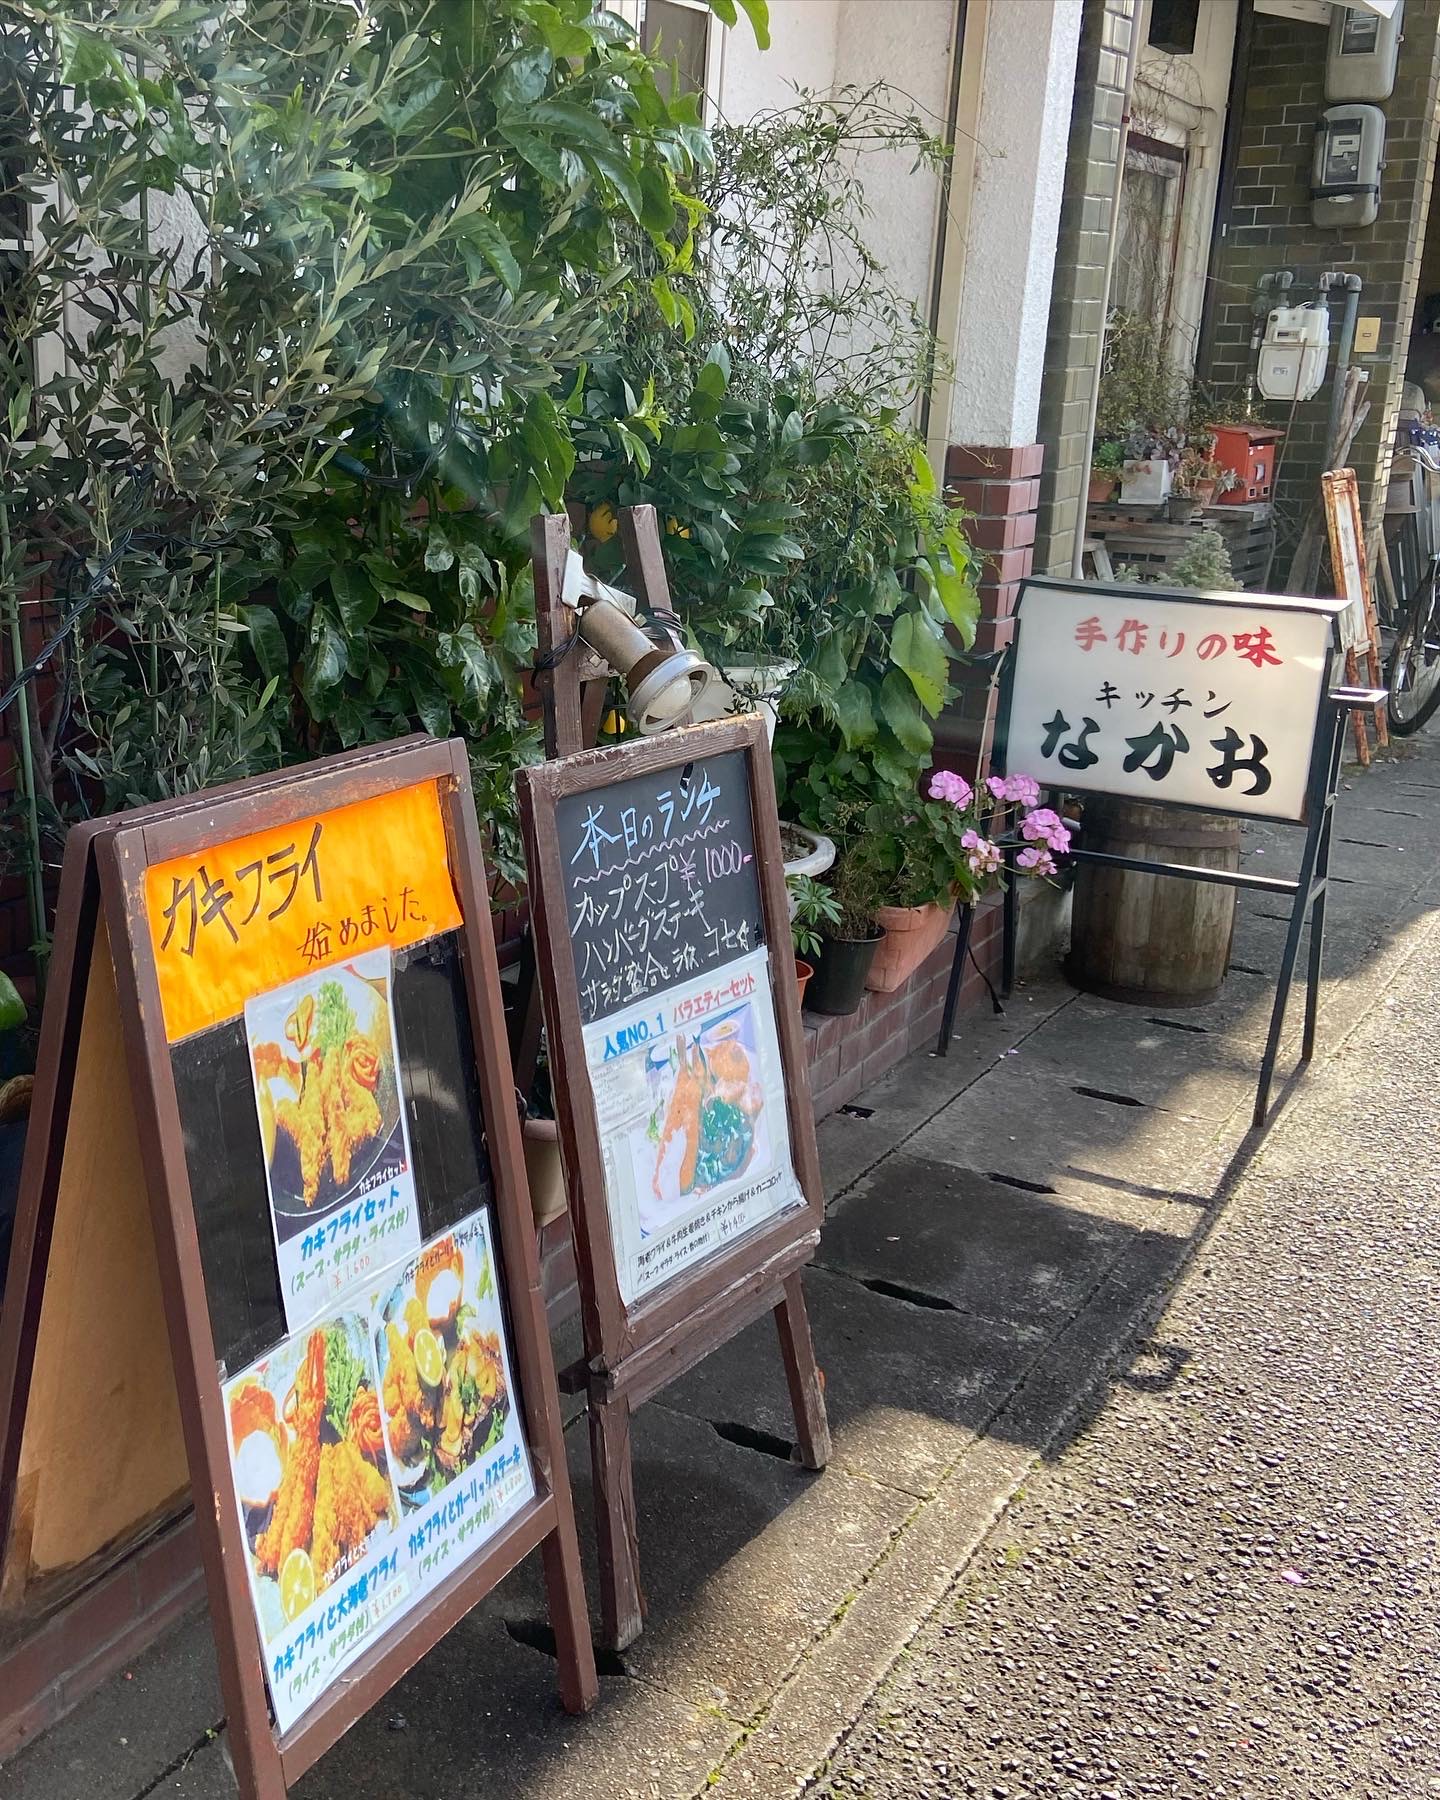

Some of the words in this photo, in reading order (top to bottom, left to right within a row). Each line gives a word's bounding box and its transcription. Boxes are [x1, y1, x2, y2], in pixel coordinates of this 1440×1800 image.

[1074, 616, 1284, 668] 手作りの味
[1096, 681, 1232, 719] キッチン
[1040, 709, 1272, 796] なかお
[571, 768, 721, 869] 本日のランチ
[160, 822, 323, 958] カキフライ
[297, 886, 427, 965] 始めました。
[570, 854, 679, 938] カップスープ
[673, 972, 756, 1022] バラエティーセット
[358, 1160, 406, 1195] カキフライセット
[301, 1184, 400, 1261] カキフライセット
[408, 1444, 521, 1559] カキフライとガーリックステーキ
